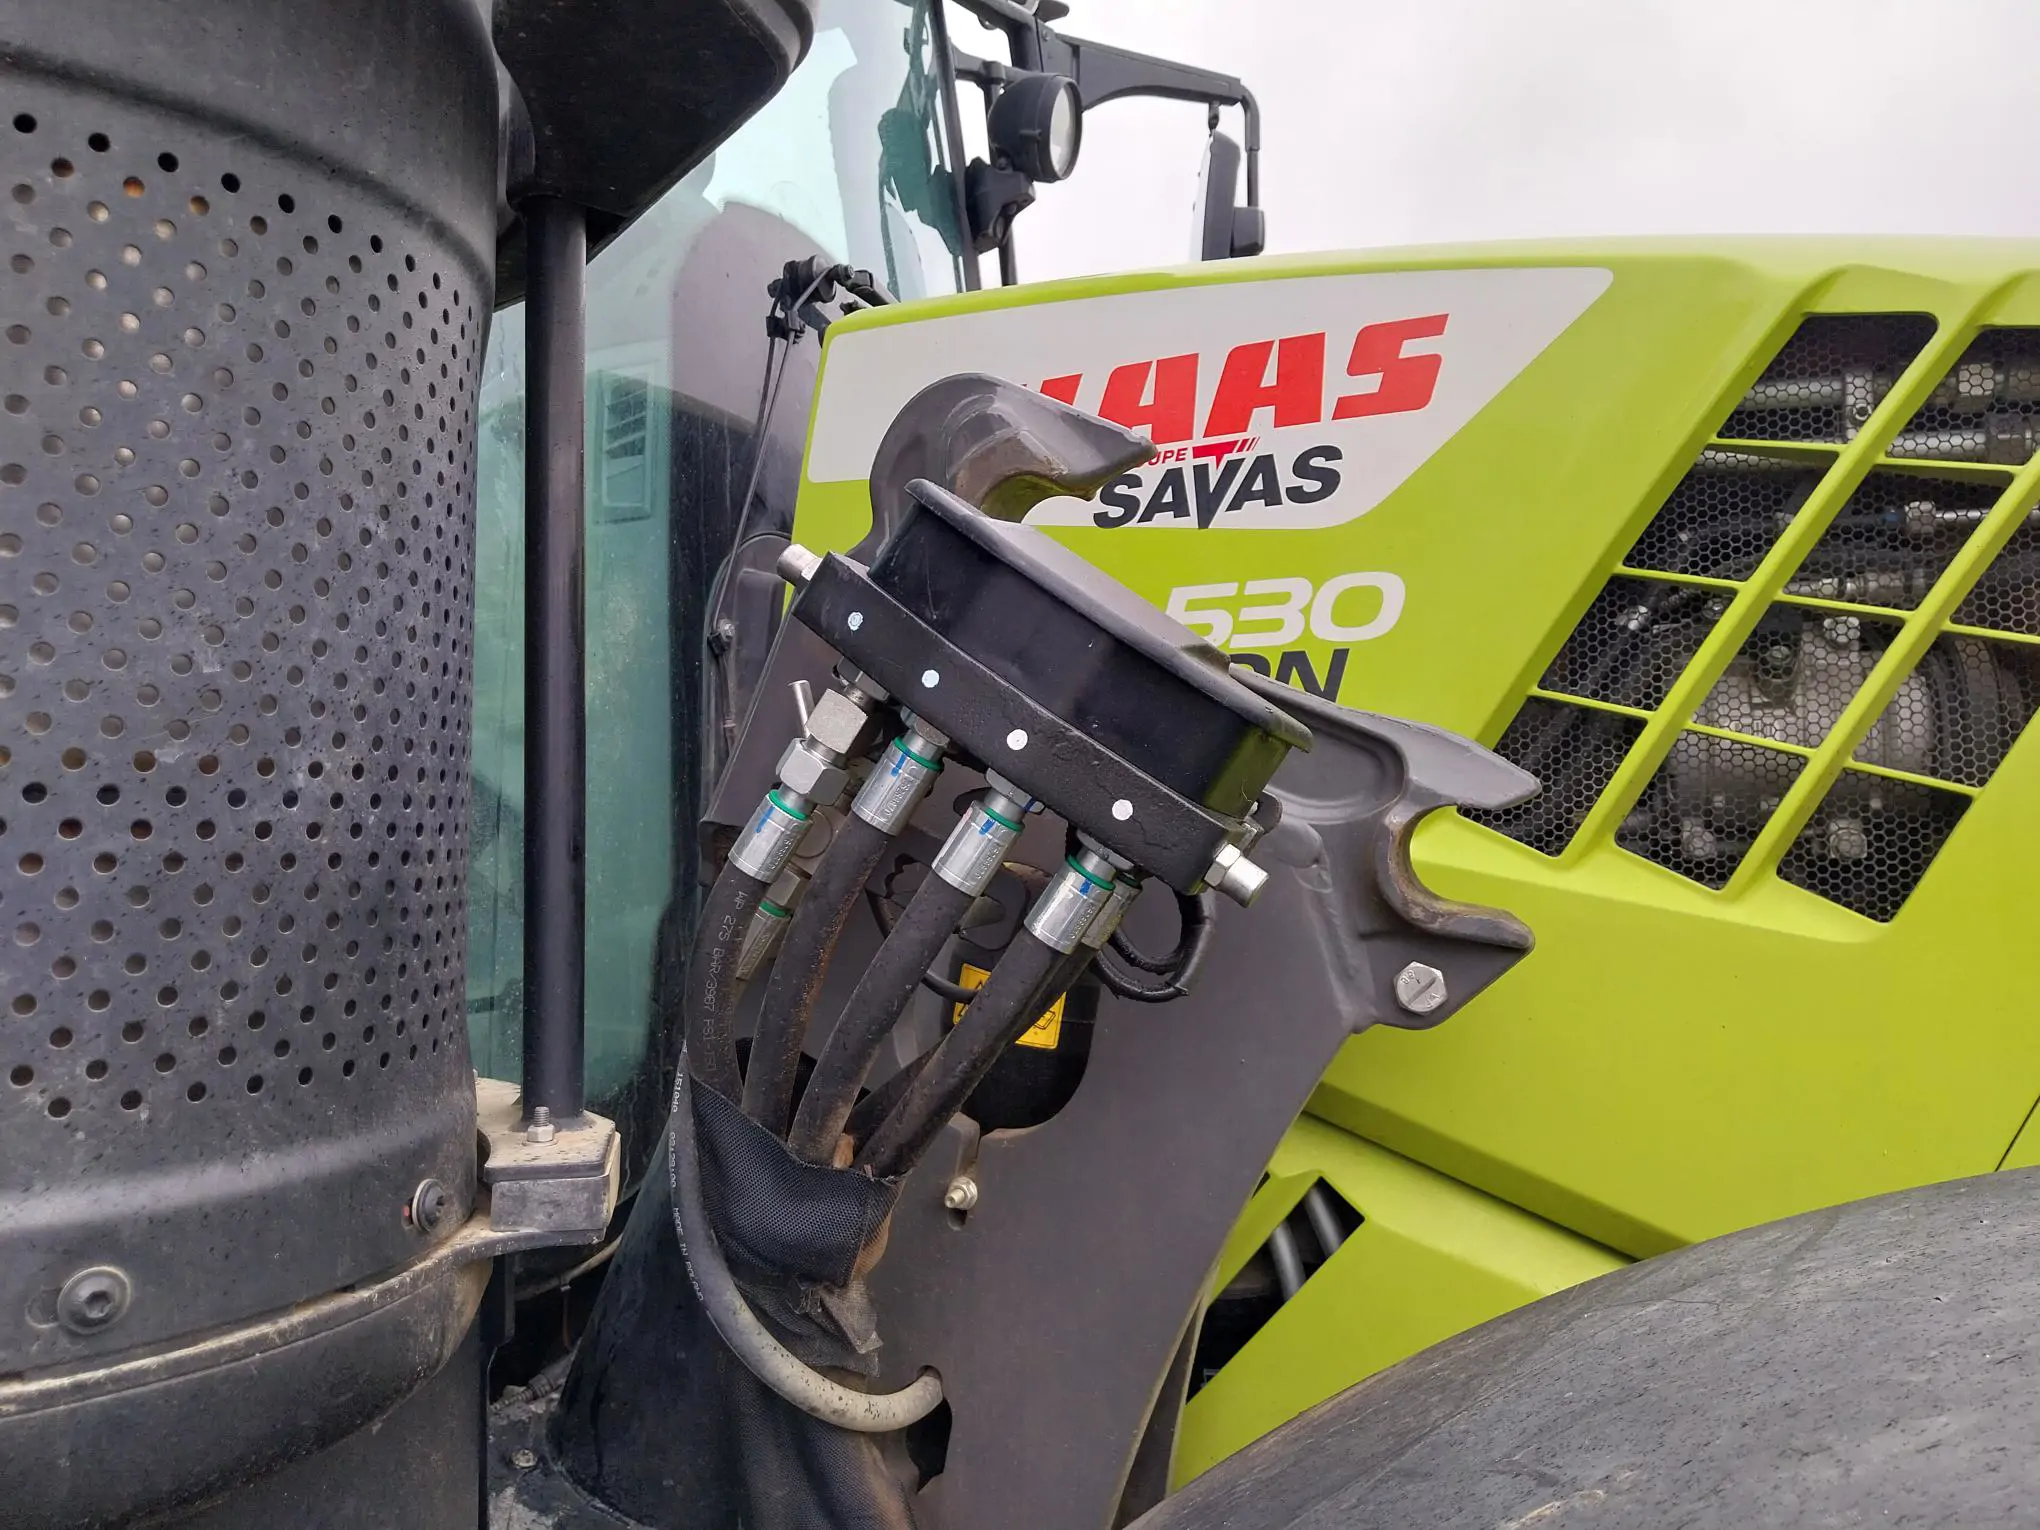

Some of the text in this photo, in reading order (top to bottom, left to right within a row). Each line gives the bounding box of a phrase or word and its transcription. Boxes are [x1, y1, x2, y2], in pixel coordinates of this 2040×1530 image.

[1022, 313, 1450, 446] AAS
[1093, 444, 1344, 530] SAVAS
[1165, 571, 1407, 650] 530
[718, 914, 737, 942] 275
